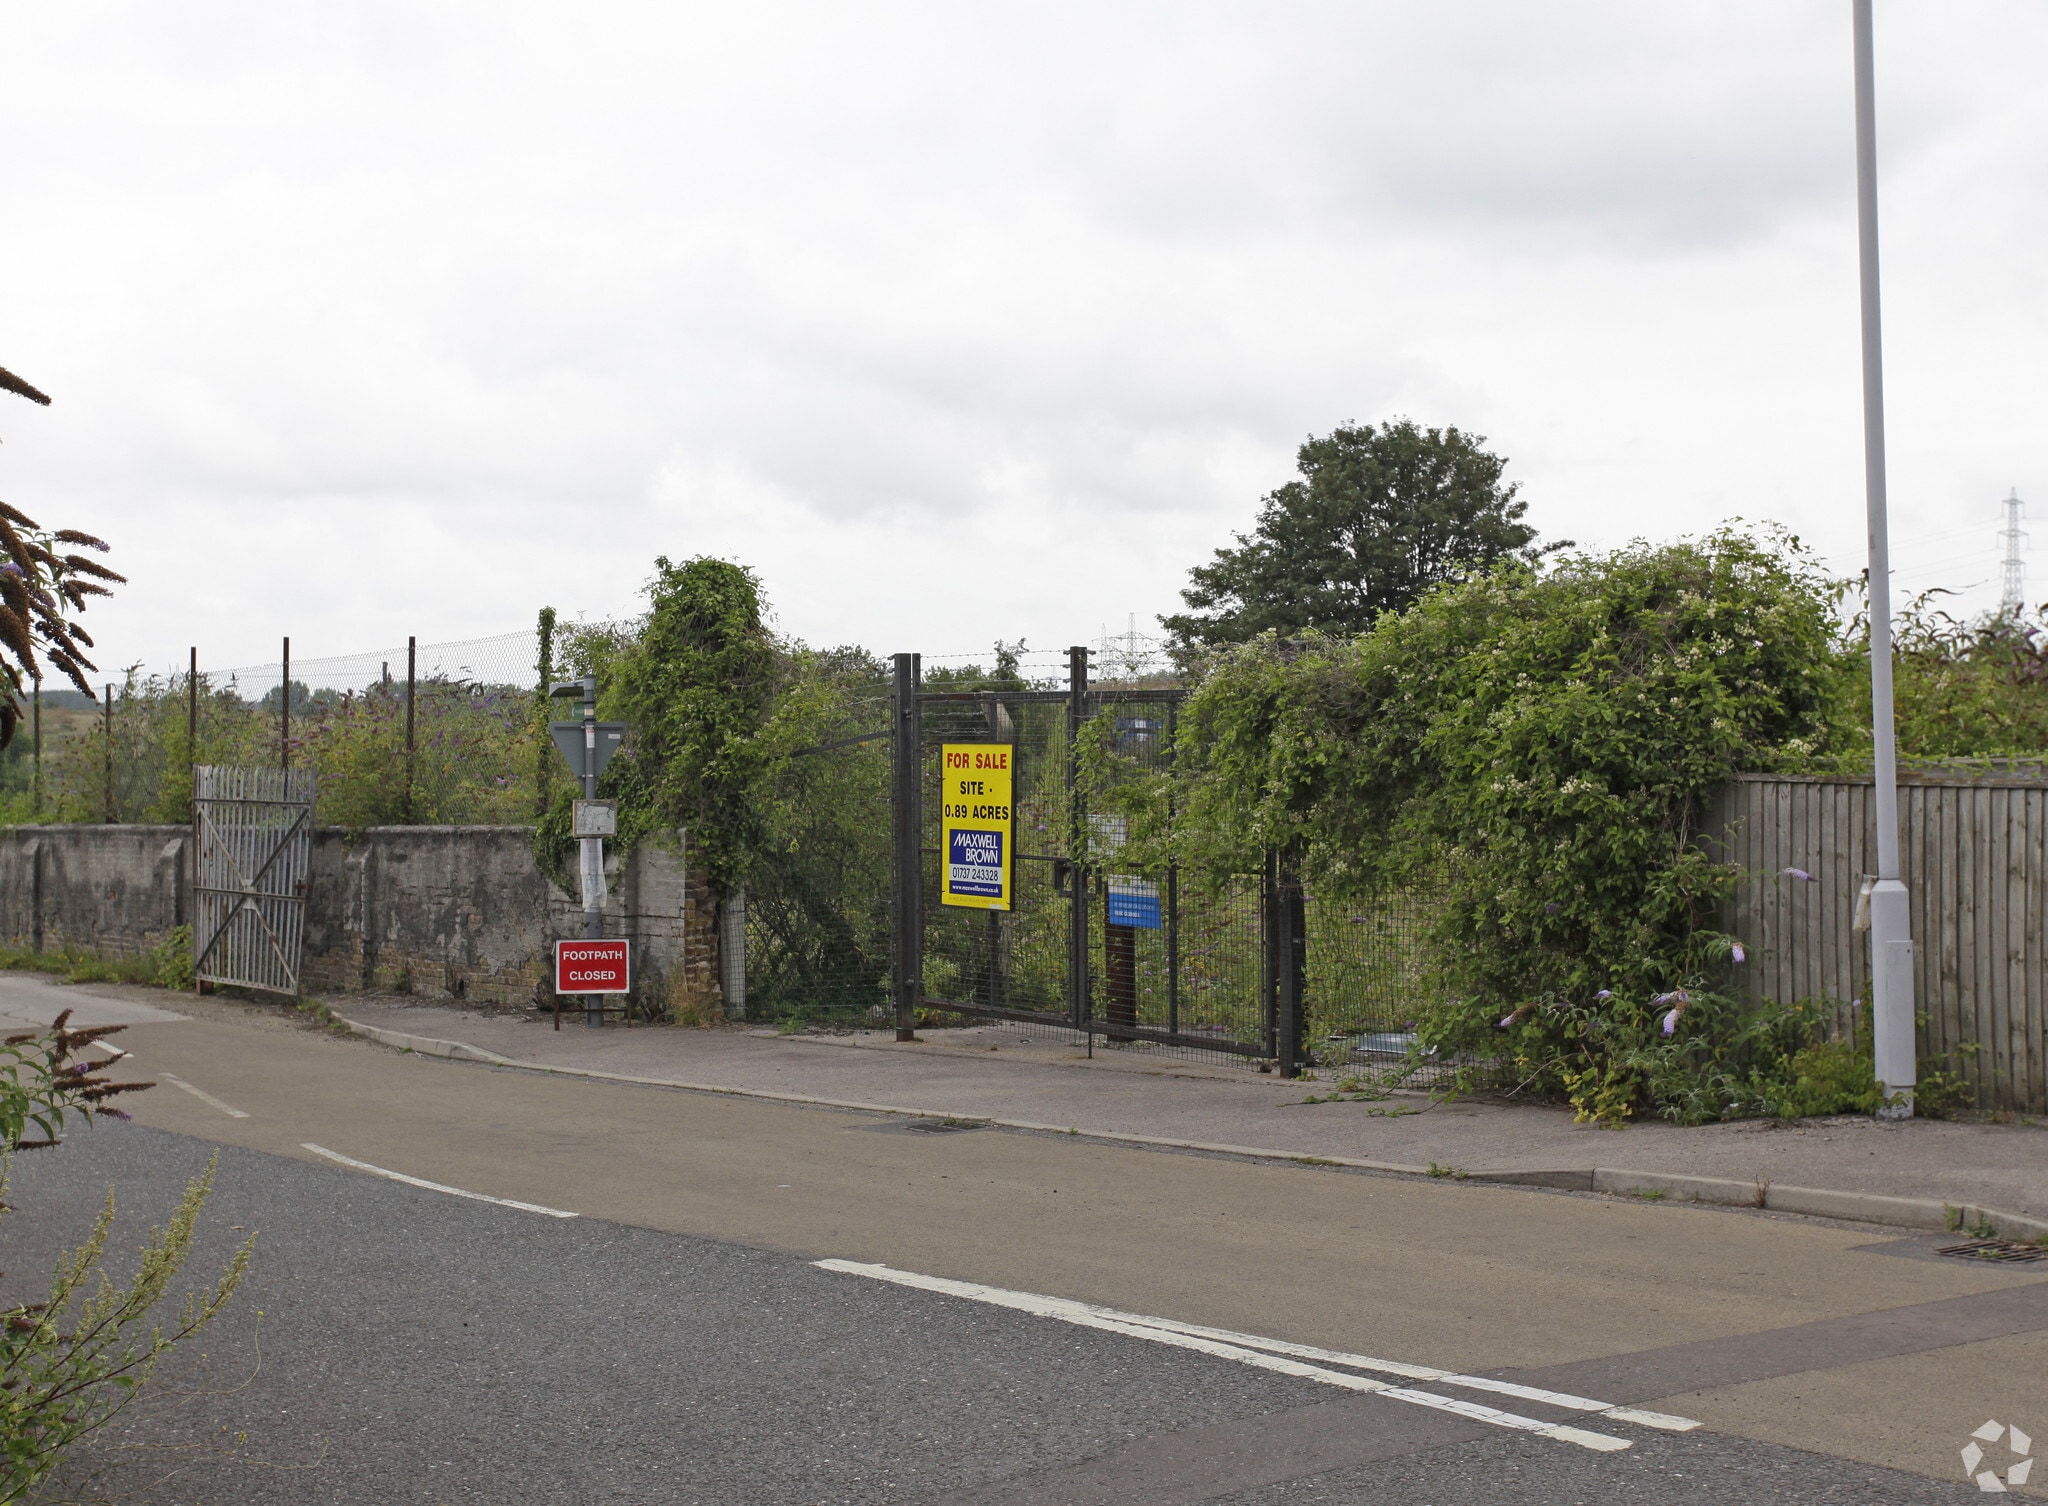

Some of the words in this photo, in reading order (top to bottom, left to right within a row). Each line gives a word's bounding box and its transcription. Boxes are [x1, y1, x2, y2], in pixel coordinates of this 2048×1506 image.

[947, 753, 970, 768] FOR
[976, 753, 1007, 769] SALE
[960, 781, 984, 795] SITE
[945, 804, 967, 818] 0.89
[972, 805, 1009, 820] ACRES
[953, 833, 998, 849] MAXWELL
[965, 848, 998, 866] BROWN
[952, 867, 970, 879] 01737
[972, 868, 999, 881] 243328
[563, 950, 623, 960] FOOTPATH
[569, 970, 616, 981] CLOSED
